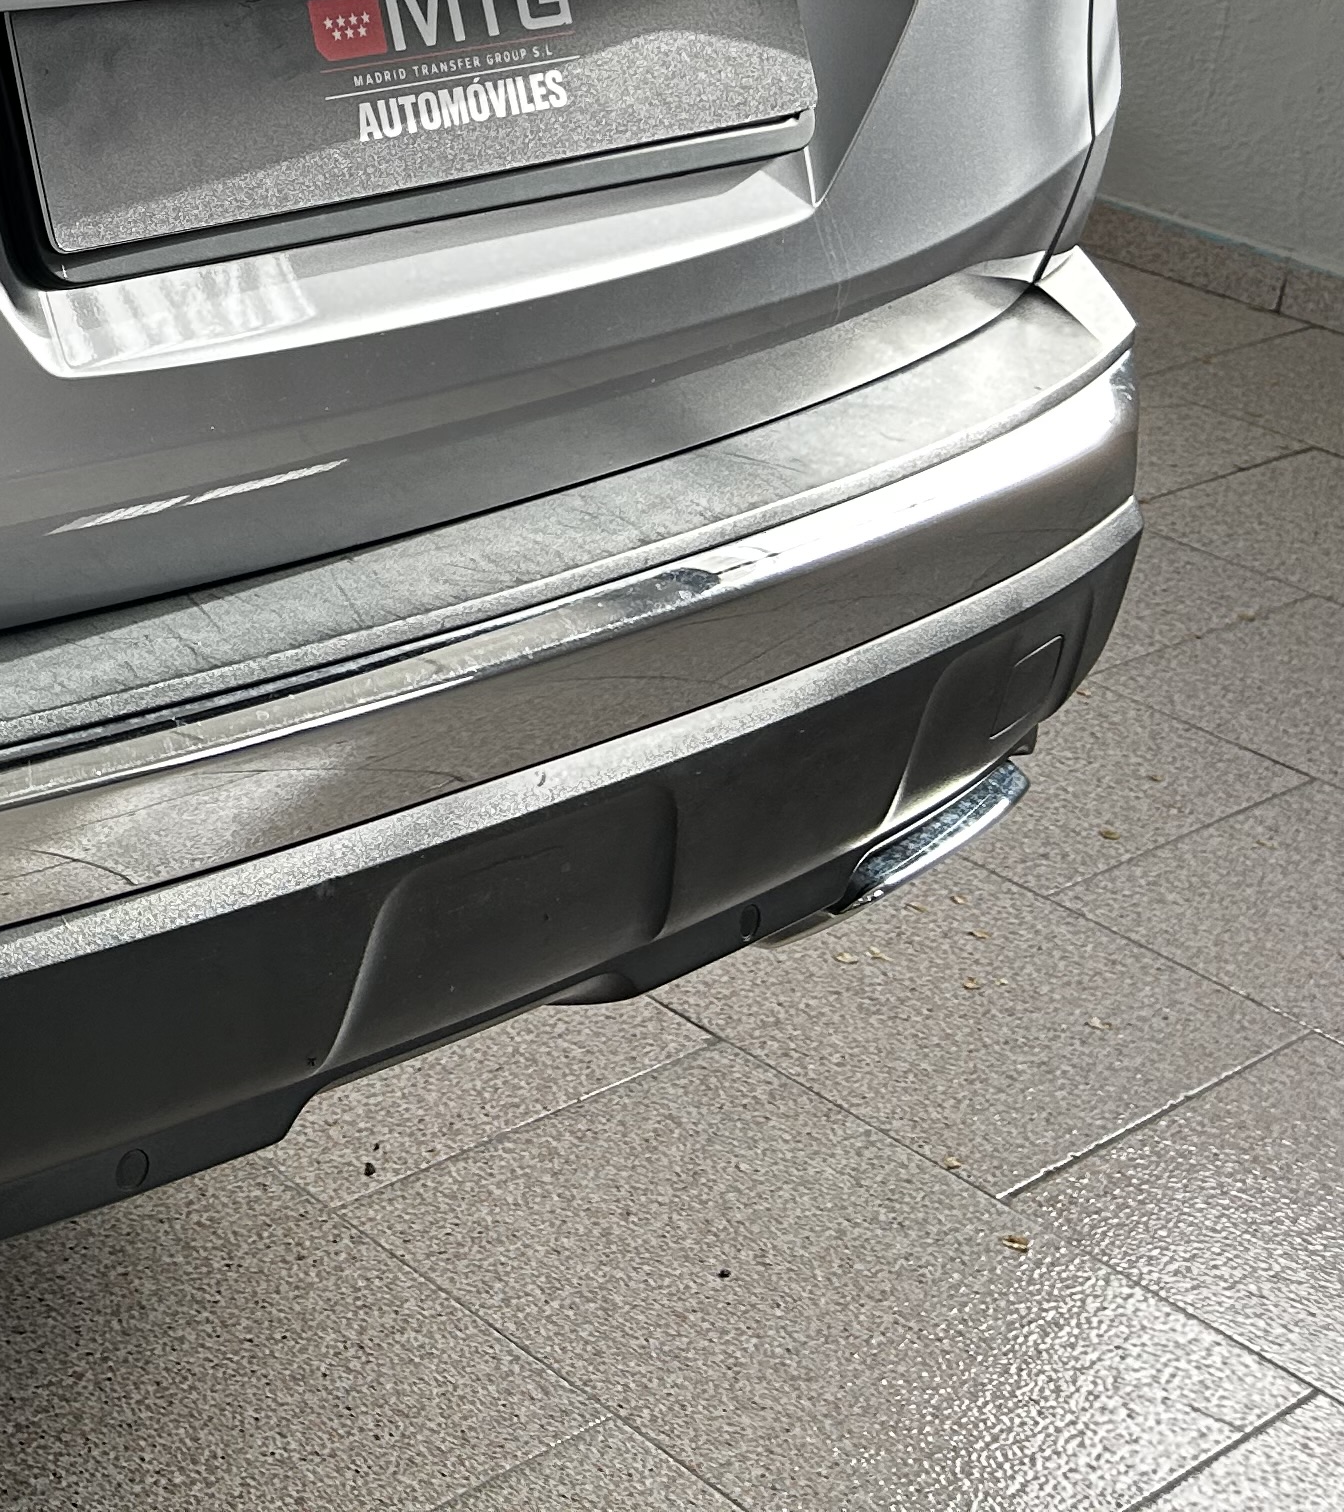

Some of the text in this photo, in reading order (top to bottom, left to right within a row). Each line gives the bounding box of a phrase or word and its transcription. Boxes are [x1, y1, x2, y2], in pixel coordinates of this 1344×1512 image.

[353, 69, 407, 88] MADRID
[412, 55, 481, 77] TRANSFER
[486, 48, 527, 65] GROUP
[358, 69, 569, 142] AUTOMÓVILES
